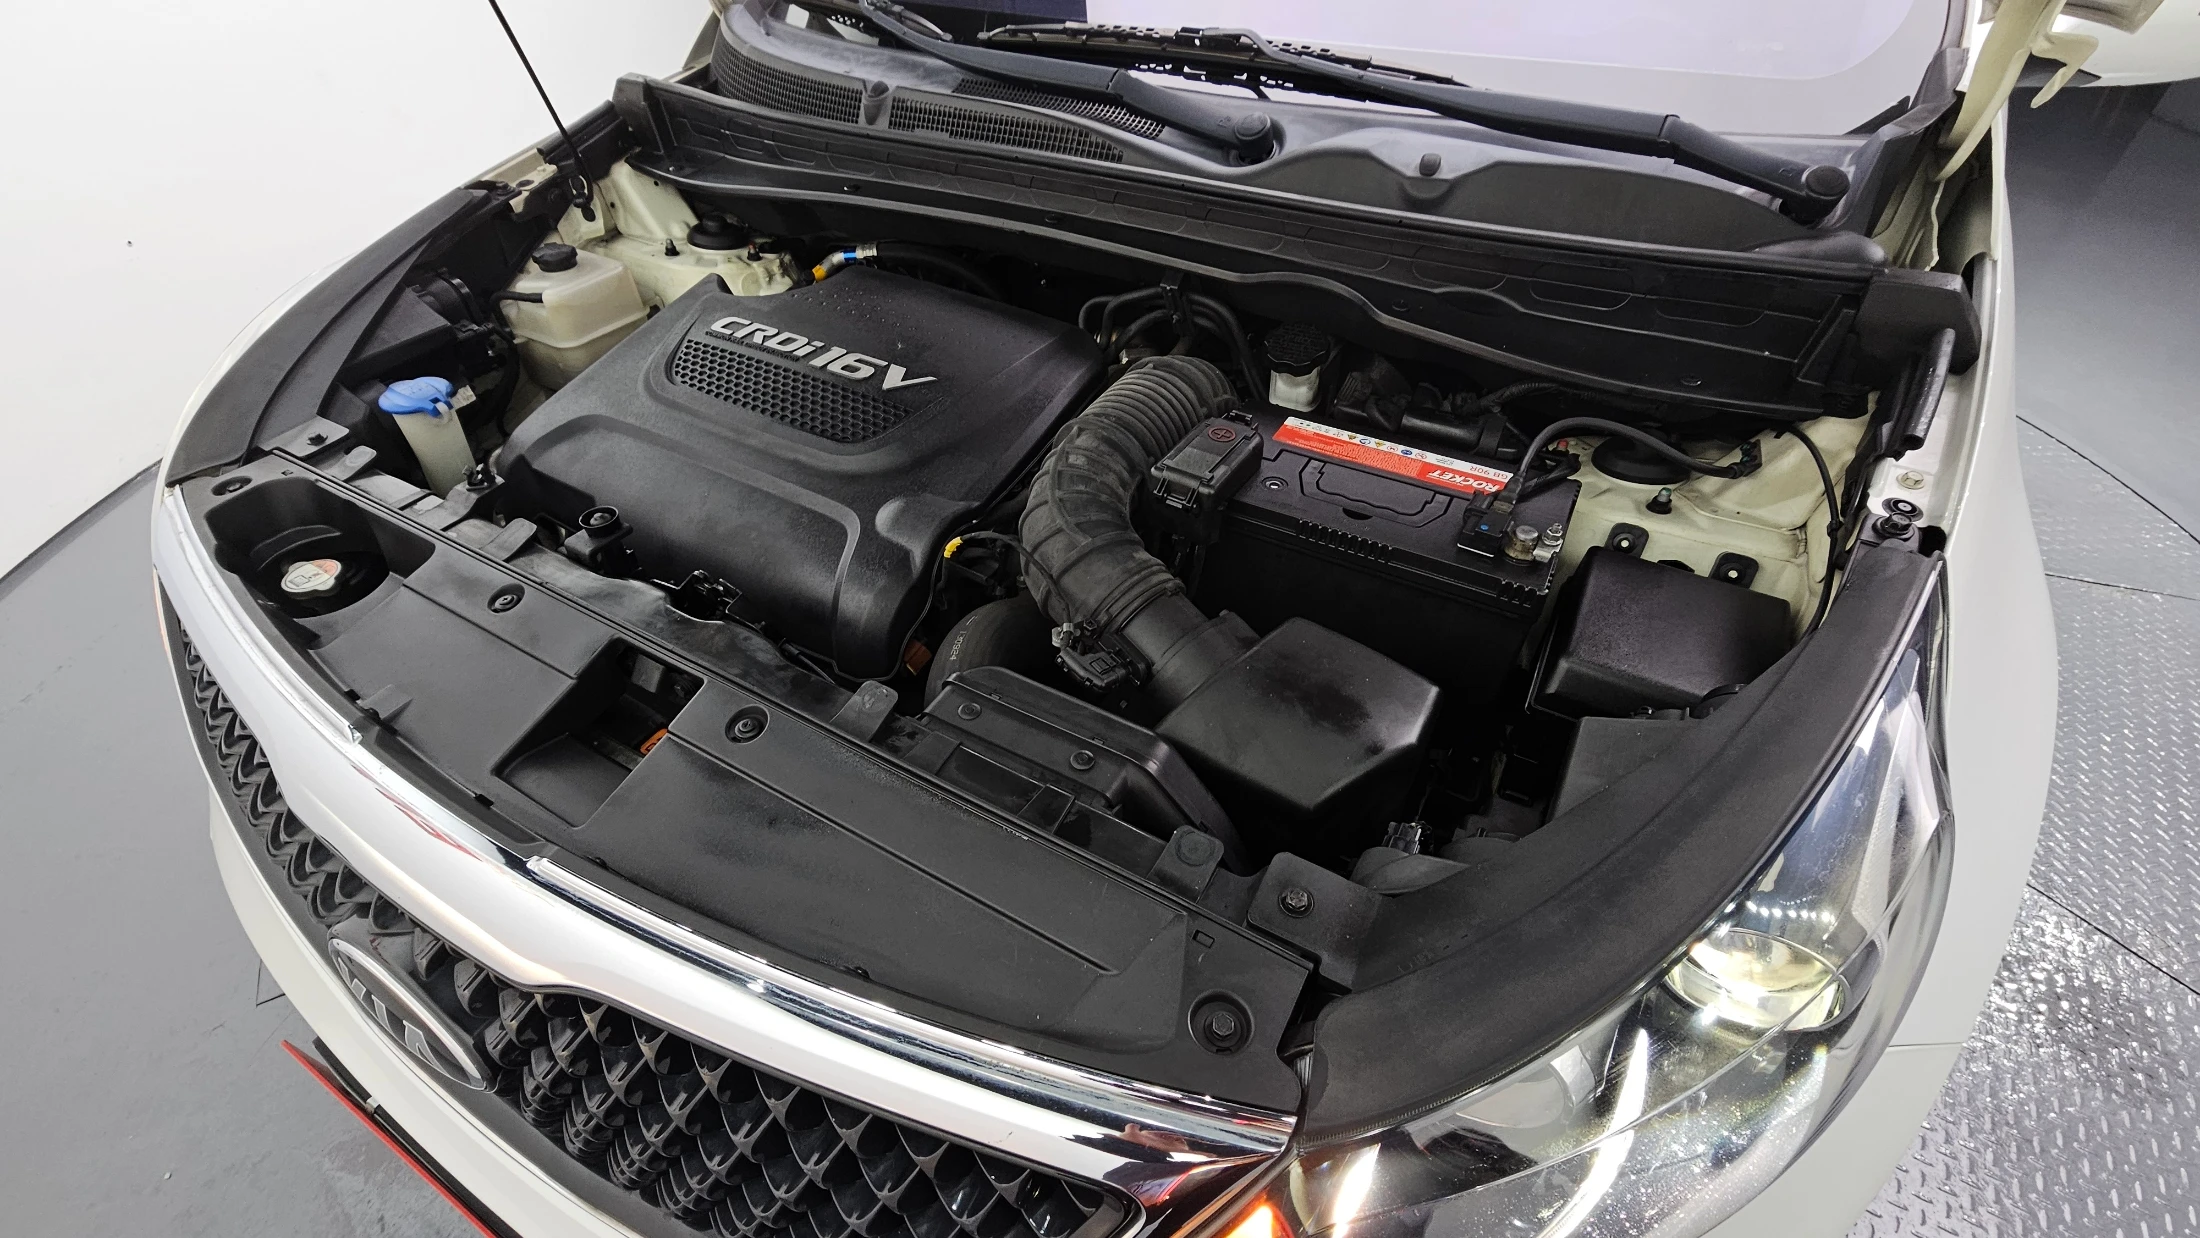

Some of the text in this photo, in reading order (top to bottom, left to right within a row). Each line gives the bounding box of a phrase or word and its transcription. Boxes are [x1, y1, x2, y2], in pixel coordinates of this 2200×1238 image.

[1427, 468, 1500, 493] ROCKET
[1469, 465, 1508, 480] GB 90R
